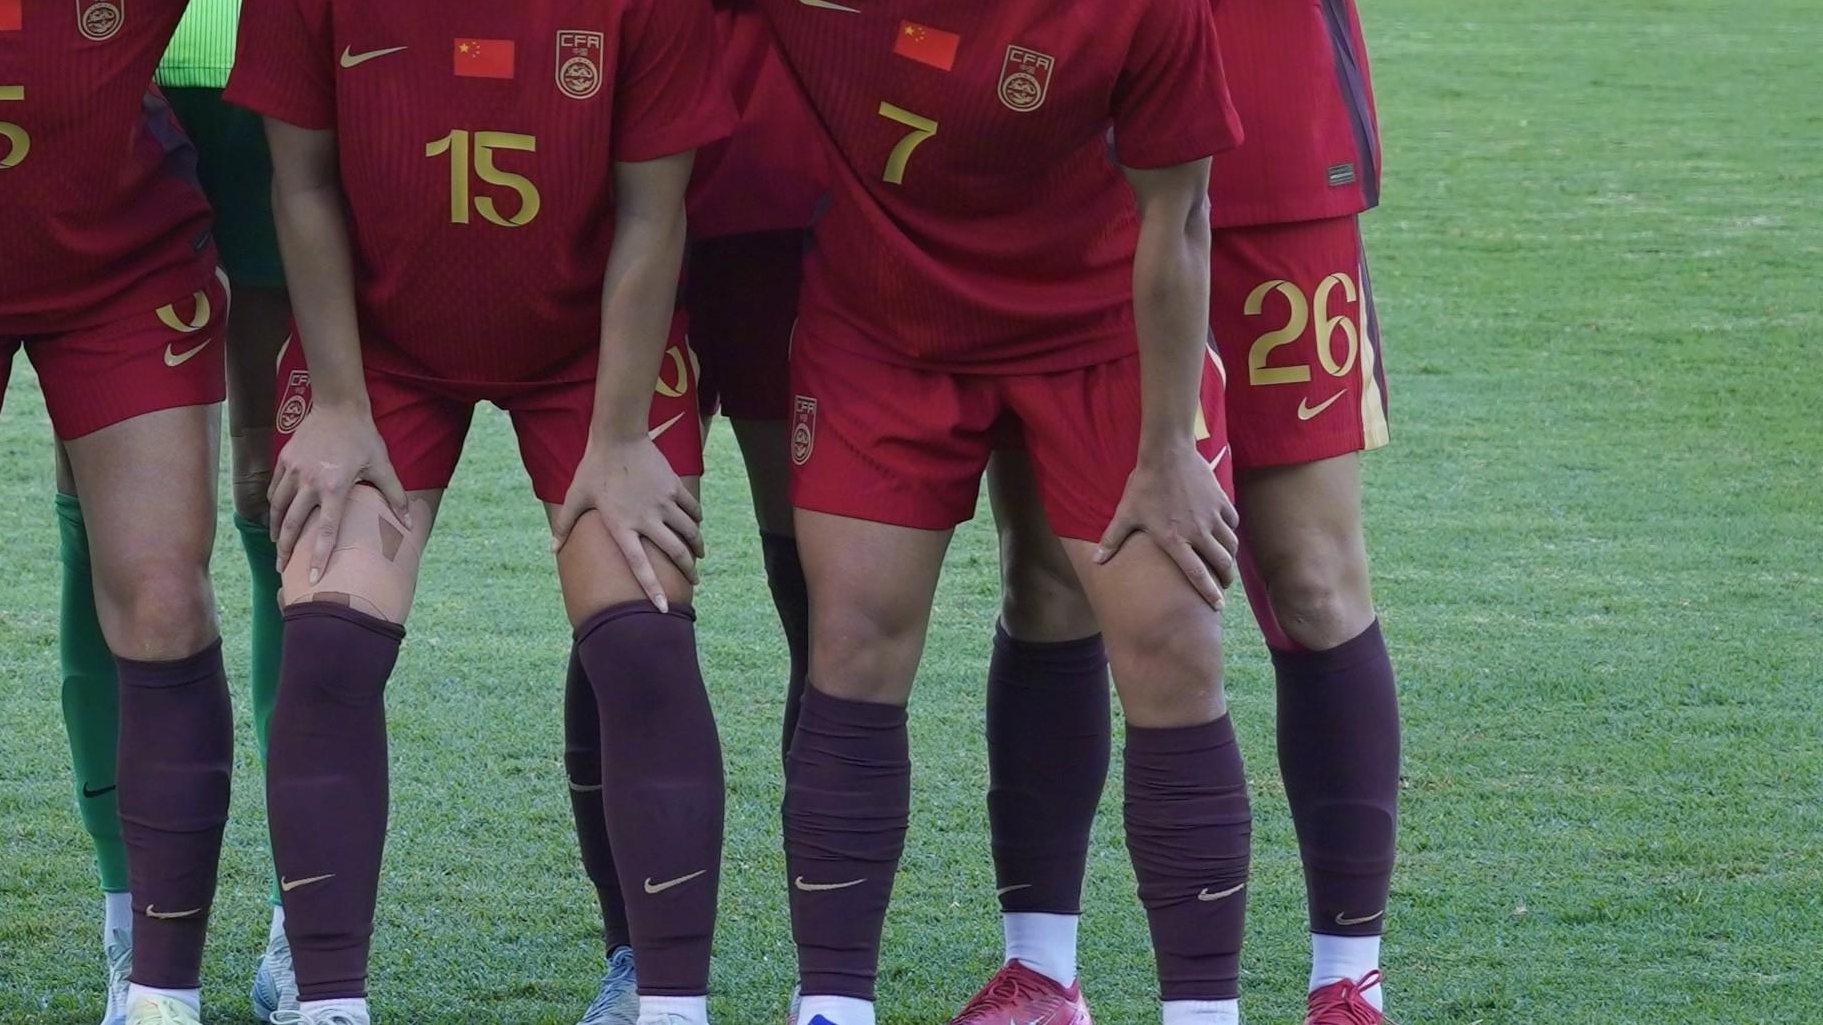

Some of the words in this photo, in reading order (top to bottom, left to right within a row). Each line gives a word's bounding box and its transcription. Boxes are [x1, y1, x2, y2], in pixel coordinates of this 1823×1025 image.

[561, 35, 600, 49] CFA
[1009, 50, 1050, 70] CFA
[425, 129, 540, 227] 15
[878, 101, 939, 185] 7
[1243, 272, 1359, 386] 26
